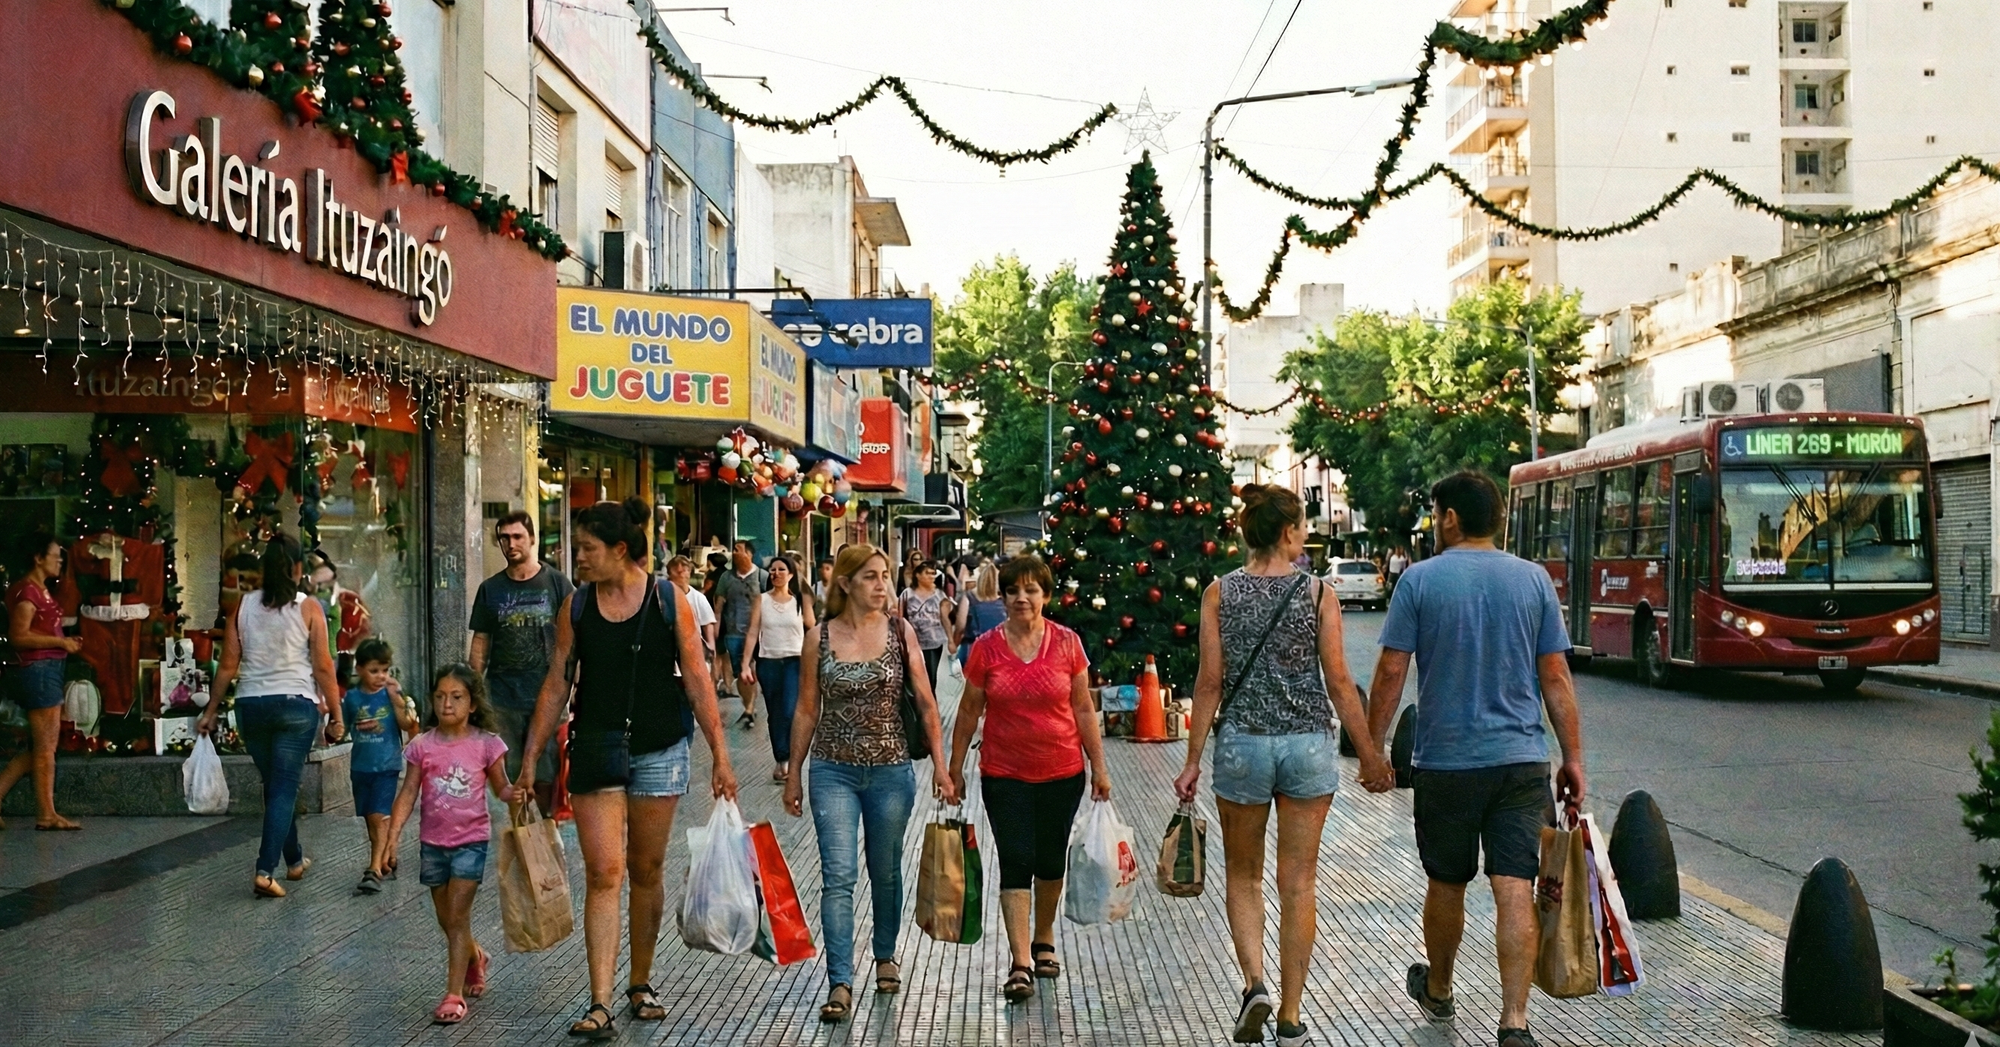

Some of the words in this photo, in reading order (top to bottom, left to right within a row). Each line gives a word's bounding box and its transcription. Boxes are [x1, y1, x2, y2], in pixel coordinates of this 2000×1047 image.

[127, 90, 301, 254] Galería
[308, 167, 452, 327] Ituzaingó
[570, 303, 605, 334] EL
[613, 308, 732, 343] MUNDO
[631, 342, 673, 365] DEL
[569, 365, 731, 406] JUGUETE
[1746, 430, 1793, 455] LÍNEA
[1797, 433, 1831, 455] 269
[1846, 427, 1902, 454] MORÓN
